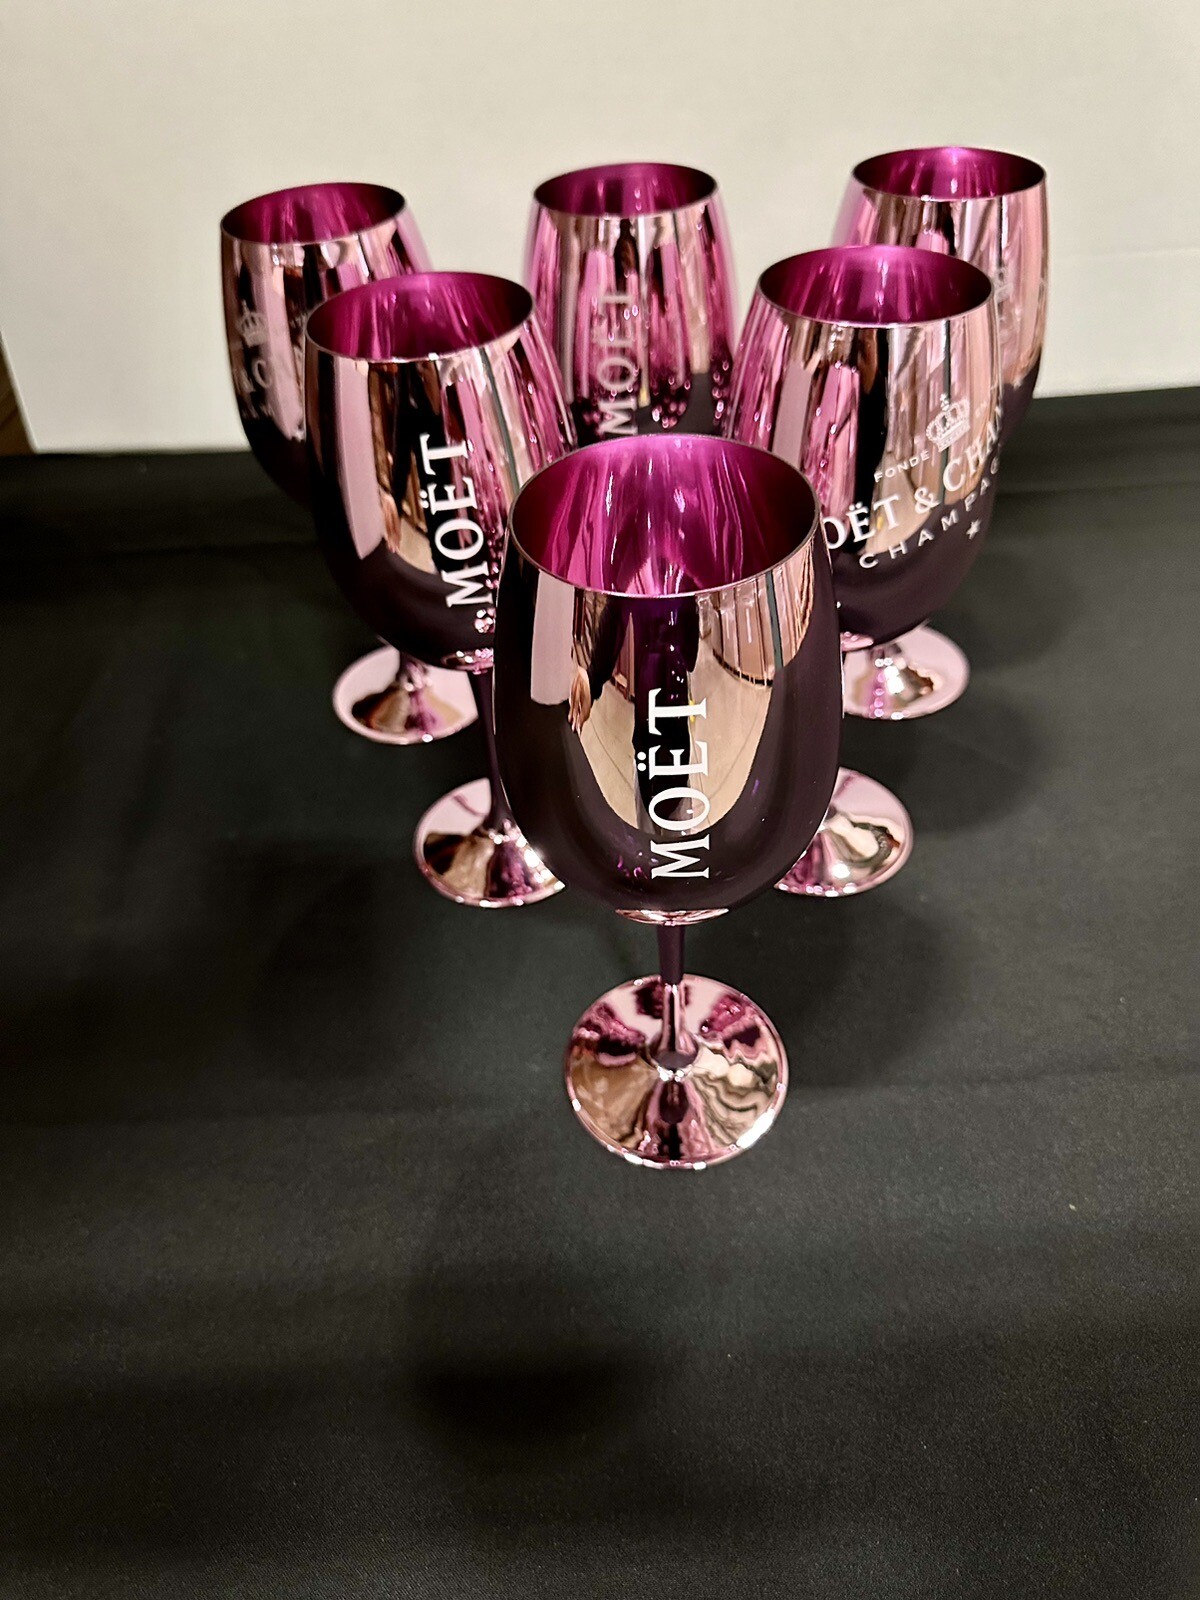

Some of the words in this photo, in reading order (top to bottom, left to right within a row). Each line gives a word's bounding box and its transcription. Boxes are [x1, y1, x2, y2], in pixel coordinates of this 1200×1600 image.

[419, 432, 494, 608] MOËT
[822, 494, 900, 550] OËT
[914, 486, 942, 515] &
[637, 687, 710, 880] MOËT
